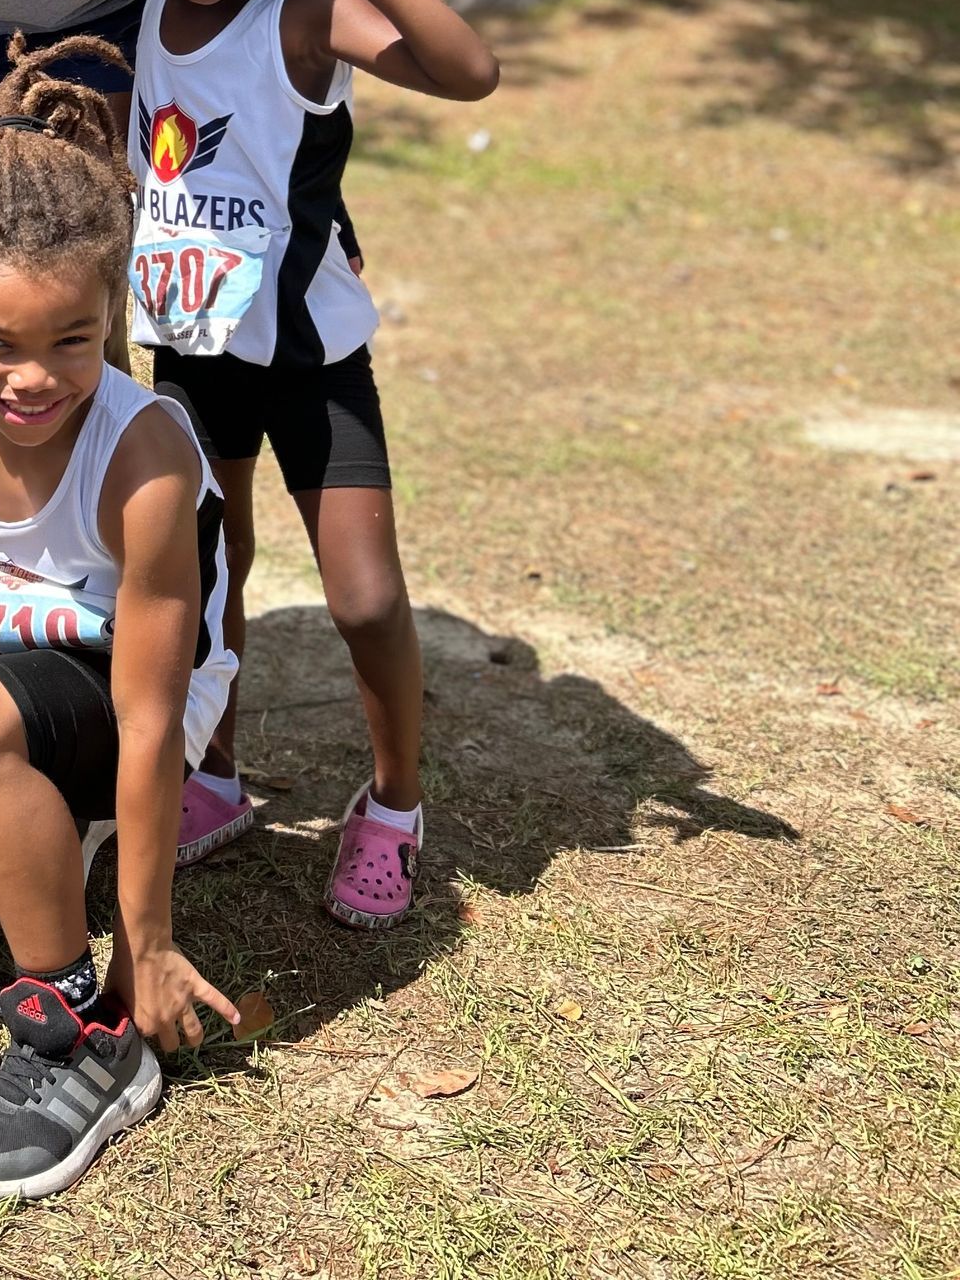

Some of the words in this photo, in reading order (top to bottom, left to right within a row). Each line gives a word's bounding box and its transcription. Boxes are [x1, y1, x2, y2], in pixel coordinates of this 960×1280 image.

[135, 247, 243, 316] 3707
[199, 328, 208, 338] FL
[17, 1004, 47, 1023] adidas
